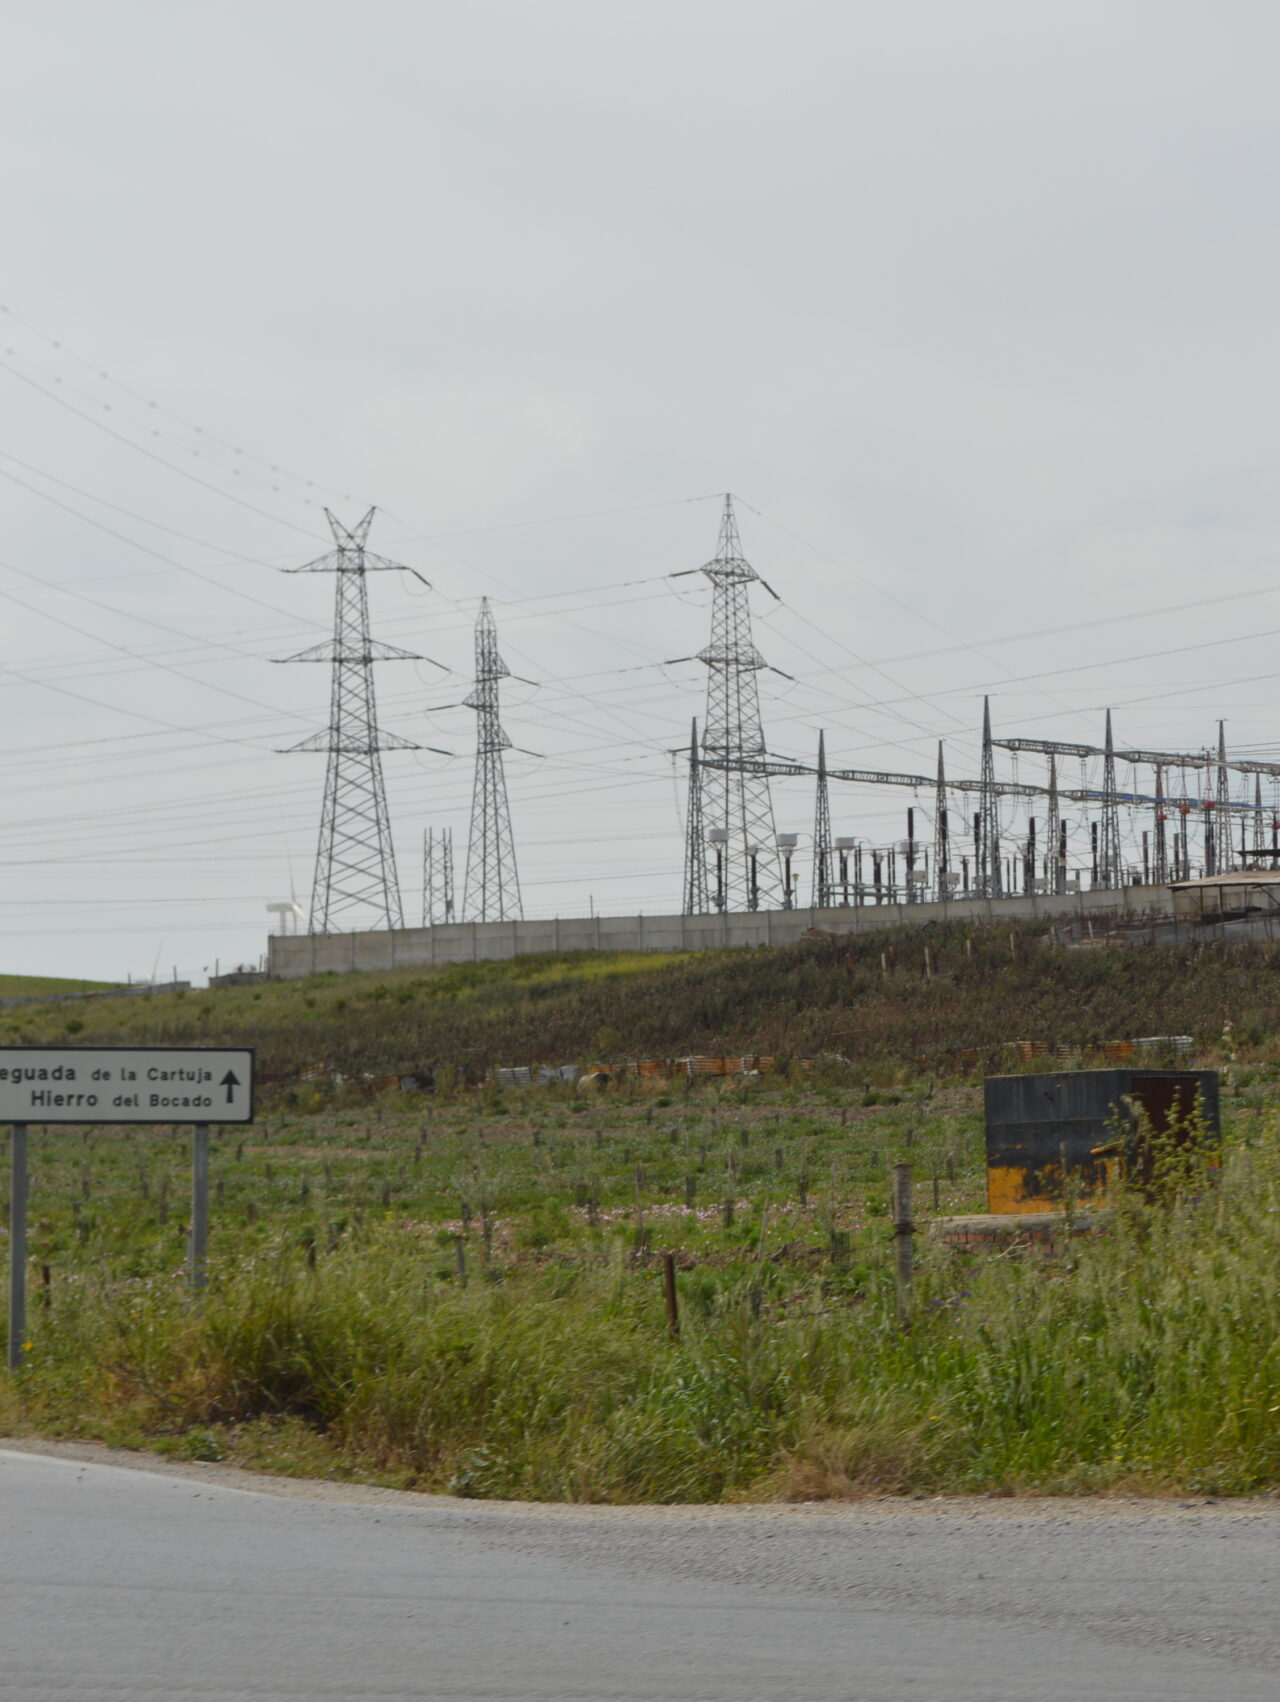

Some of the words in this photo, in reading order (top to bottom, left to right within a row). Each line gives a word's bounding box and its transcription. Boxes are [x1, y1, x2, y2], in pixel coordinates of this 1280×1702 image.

[0, 1065, 76, 1083] eguada
[91, 1068, 111, 1082] de
[121, 1068, 137, 1082] la
[146, 1067, 213, 1084] Cartuja
[30, 1090, 98, 1107] Hierro
[112, 1094, 140, 1107] del
[149, 1094, 213, 1108] Bocado
